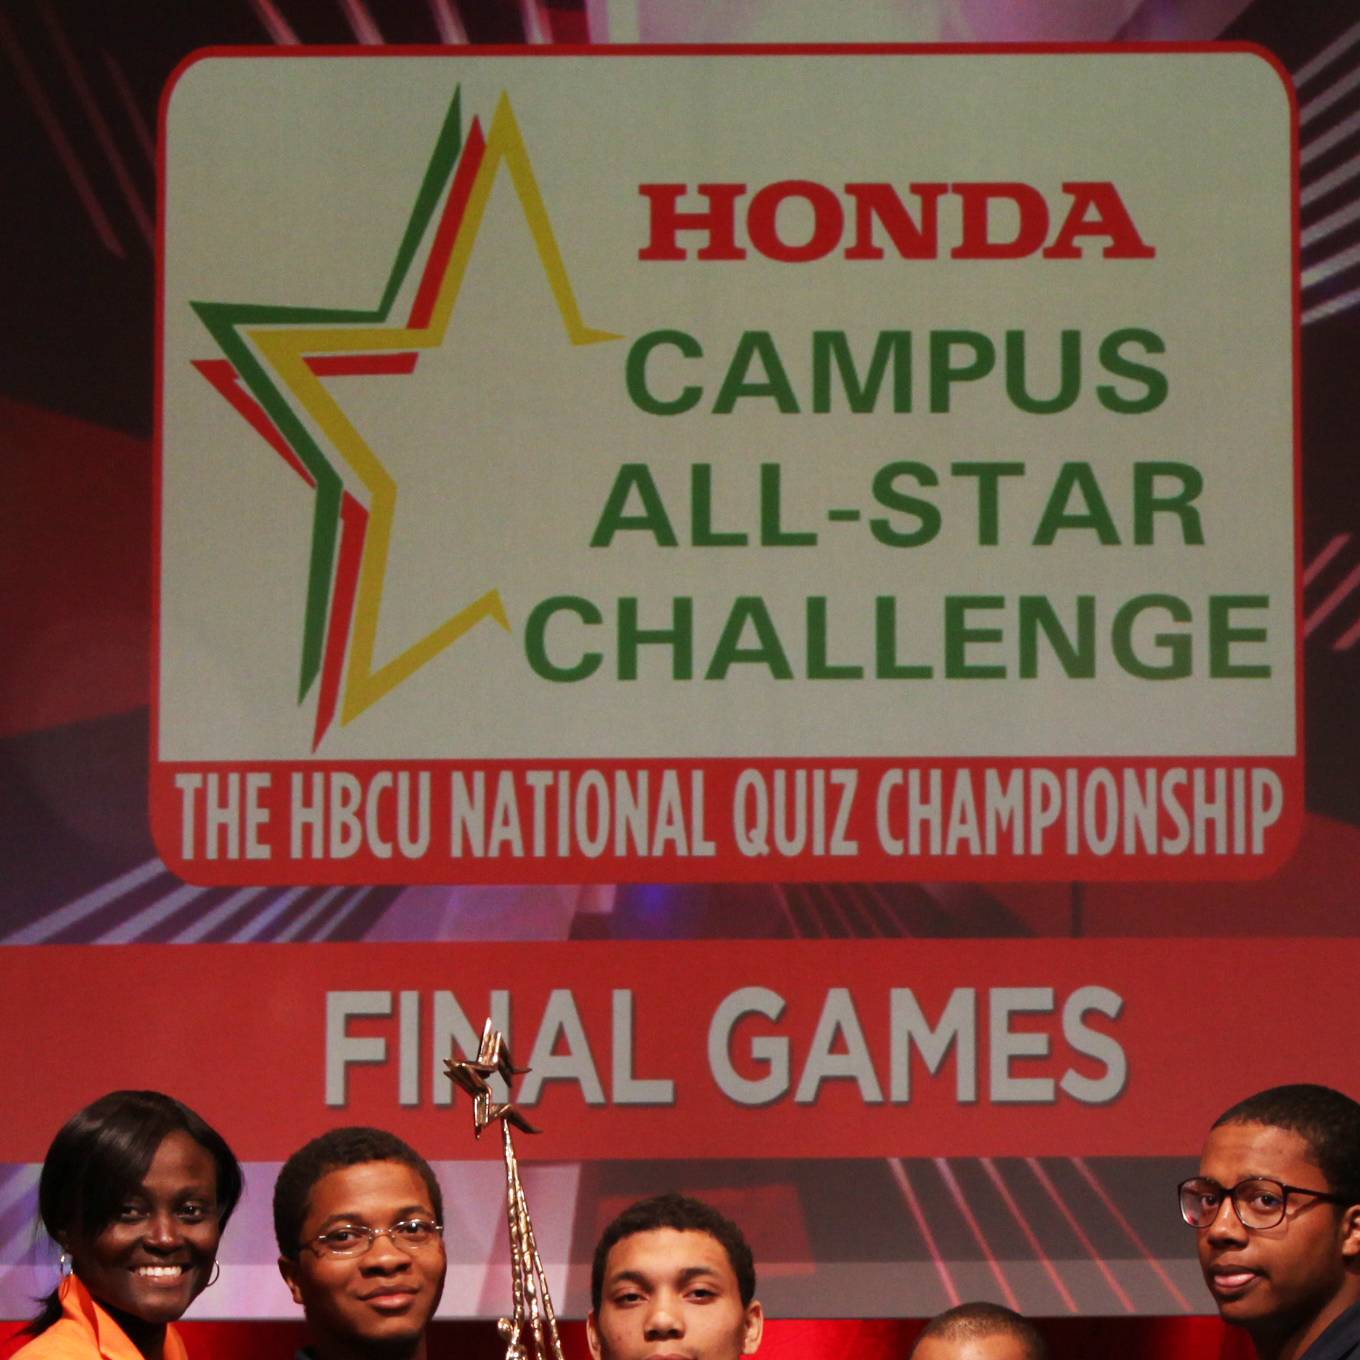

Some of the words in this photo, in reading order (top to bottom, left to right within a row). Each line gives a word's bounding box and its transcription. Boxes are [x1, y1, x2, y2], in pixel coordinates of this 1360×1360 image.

[638, 179, 1156, 263] HONDA
[624, 328, 1169, 416] CAMPUS
[589, 460, 1205, 548] ALL-STAR
[523, 594, 1272, 683] CHALLENGE
[175, 772, 271, 860] THE
[290, 771, 431, 860] HBCU
[451, 769, 716, 858] NATIONAL
[733, 768, 859, 857] QUIZ
[876, 767, 1284, 857] CHAMPIONSHIP
[324, 988, 675, 1107] FINAL
[707, 986, 1128, 1105] GAMES
